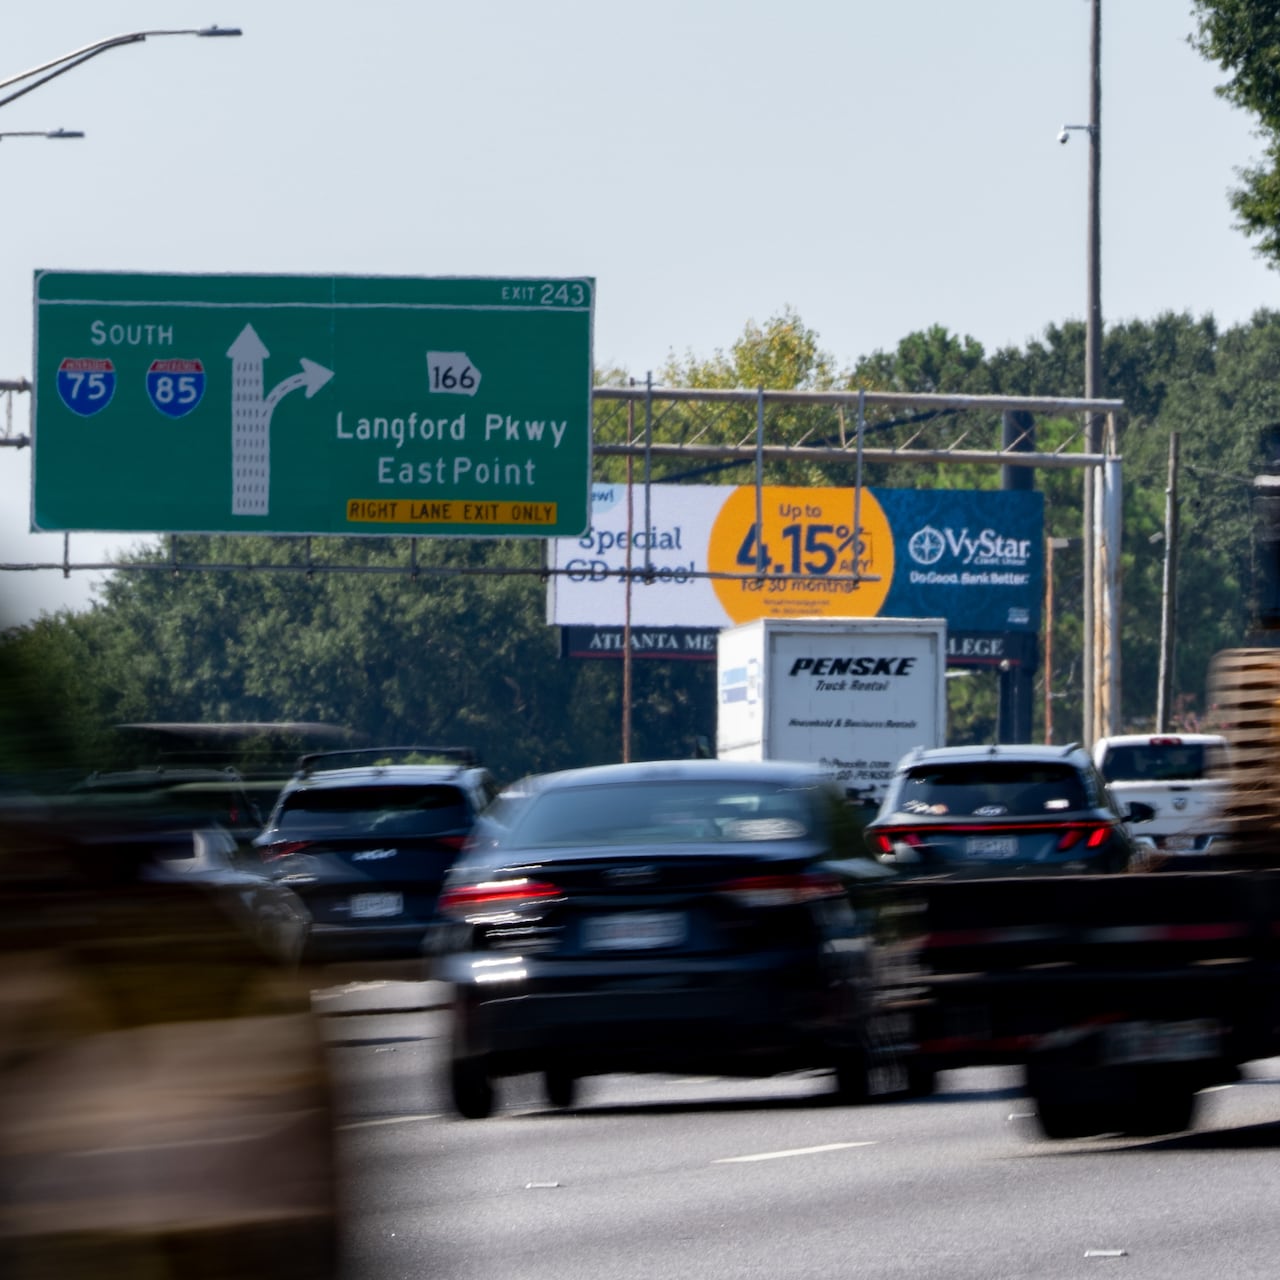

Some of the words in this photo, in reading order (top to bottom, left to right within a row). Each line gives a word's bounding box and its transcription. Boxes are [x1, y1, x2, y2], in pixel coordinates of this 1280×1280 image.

[501, 286, 535, 301] EXIT
[540, 283, 584, 305] 243
[91, 320, 174, 346] SOUTH
[67, 373, 106, 400] 75
[155, 376, 197, 404] 85
[432, 365, 475, 390] 166
[336, 411, 466, 448] Langford
[484, 413, 568, 448] Pkwy
[349, 502, 398, 518] RIGHT
[410, 503, 452, 520] LANE
[463, 504, 500, 520] EXIT
[512, 505, 553, 522] ONLY
[779, 504, 802, 520] Up
[806, 504, 821, 518] to
[579, 526, 682, 555] Special
[736, 522, 866, 575] 4.15%
[590, 633, 679, 649] ATLANTA
[789, 657, 917, 677] PENSKE
[816, 680, 847, 692] Truck
[850, 680, 889, 692] Rental
